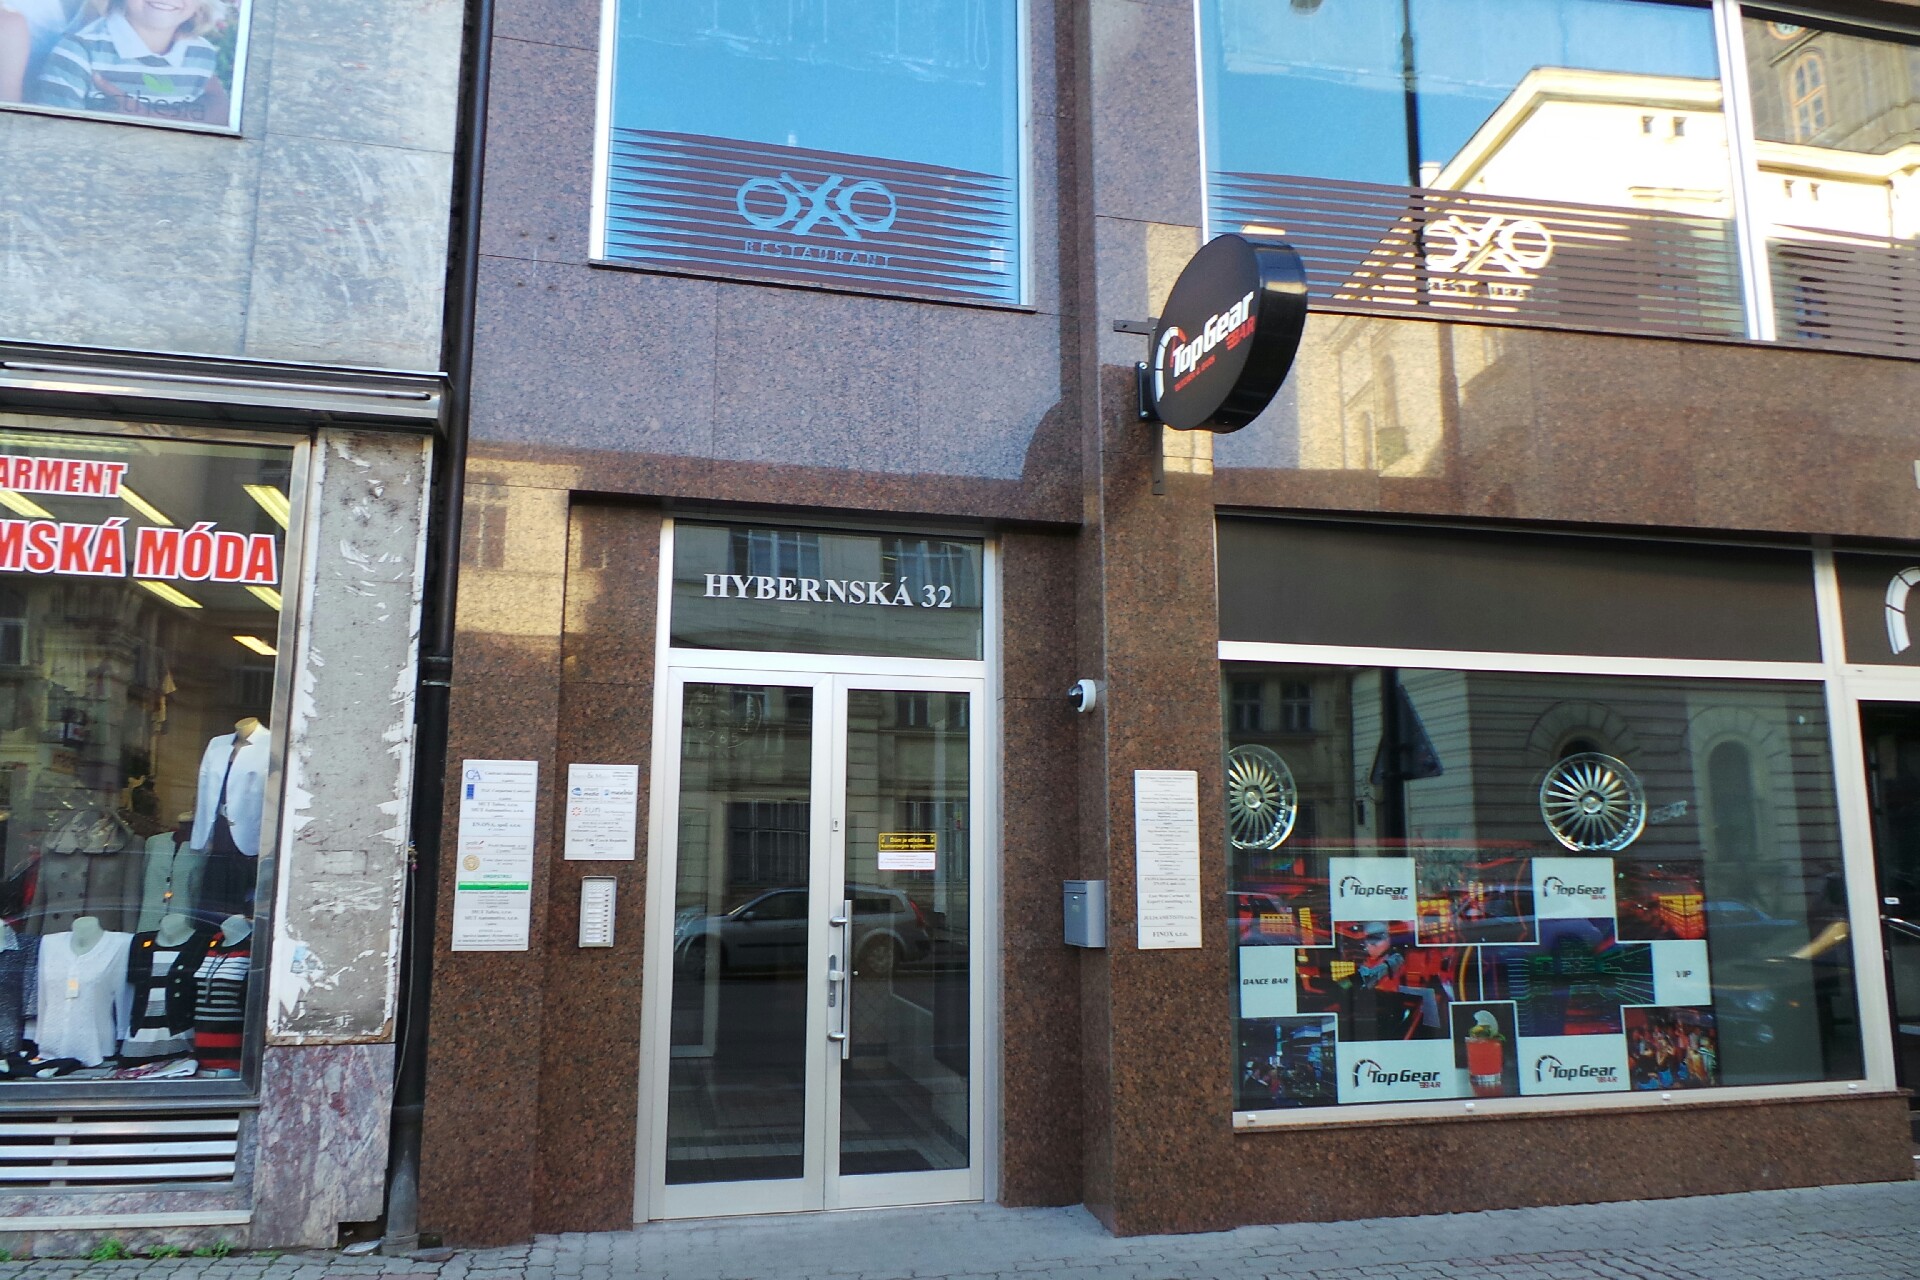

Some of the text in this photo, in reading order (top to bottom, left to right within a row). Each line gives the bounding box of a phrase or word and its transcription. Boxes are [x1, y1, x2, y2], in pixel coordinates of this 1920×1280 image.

[736, 172, 897, 242] OXO
[743, 240, 890, 269] RESTAURANT
[133, 521, 278, 584] MÓDA
[703, 573, 954, 609] HYBERNSKÁ 32
[1675, 969, 1692, 978] VIP
